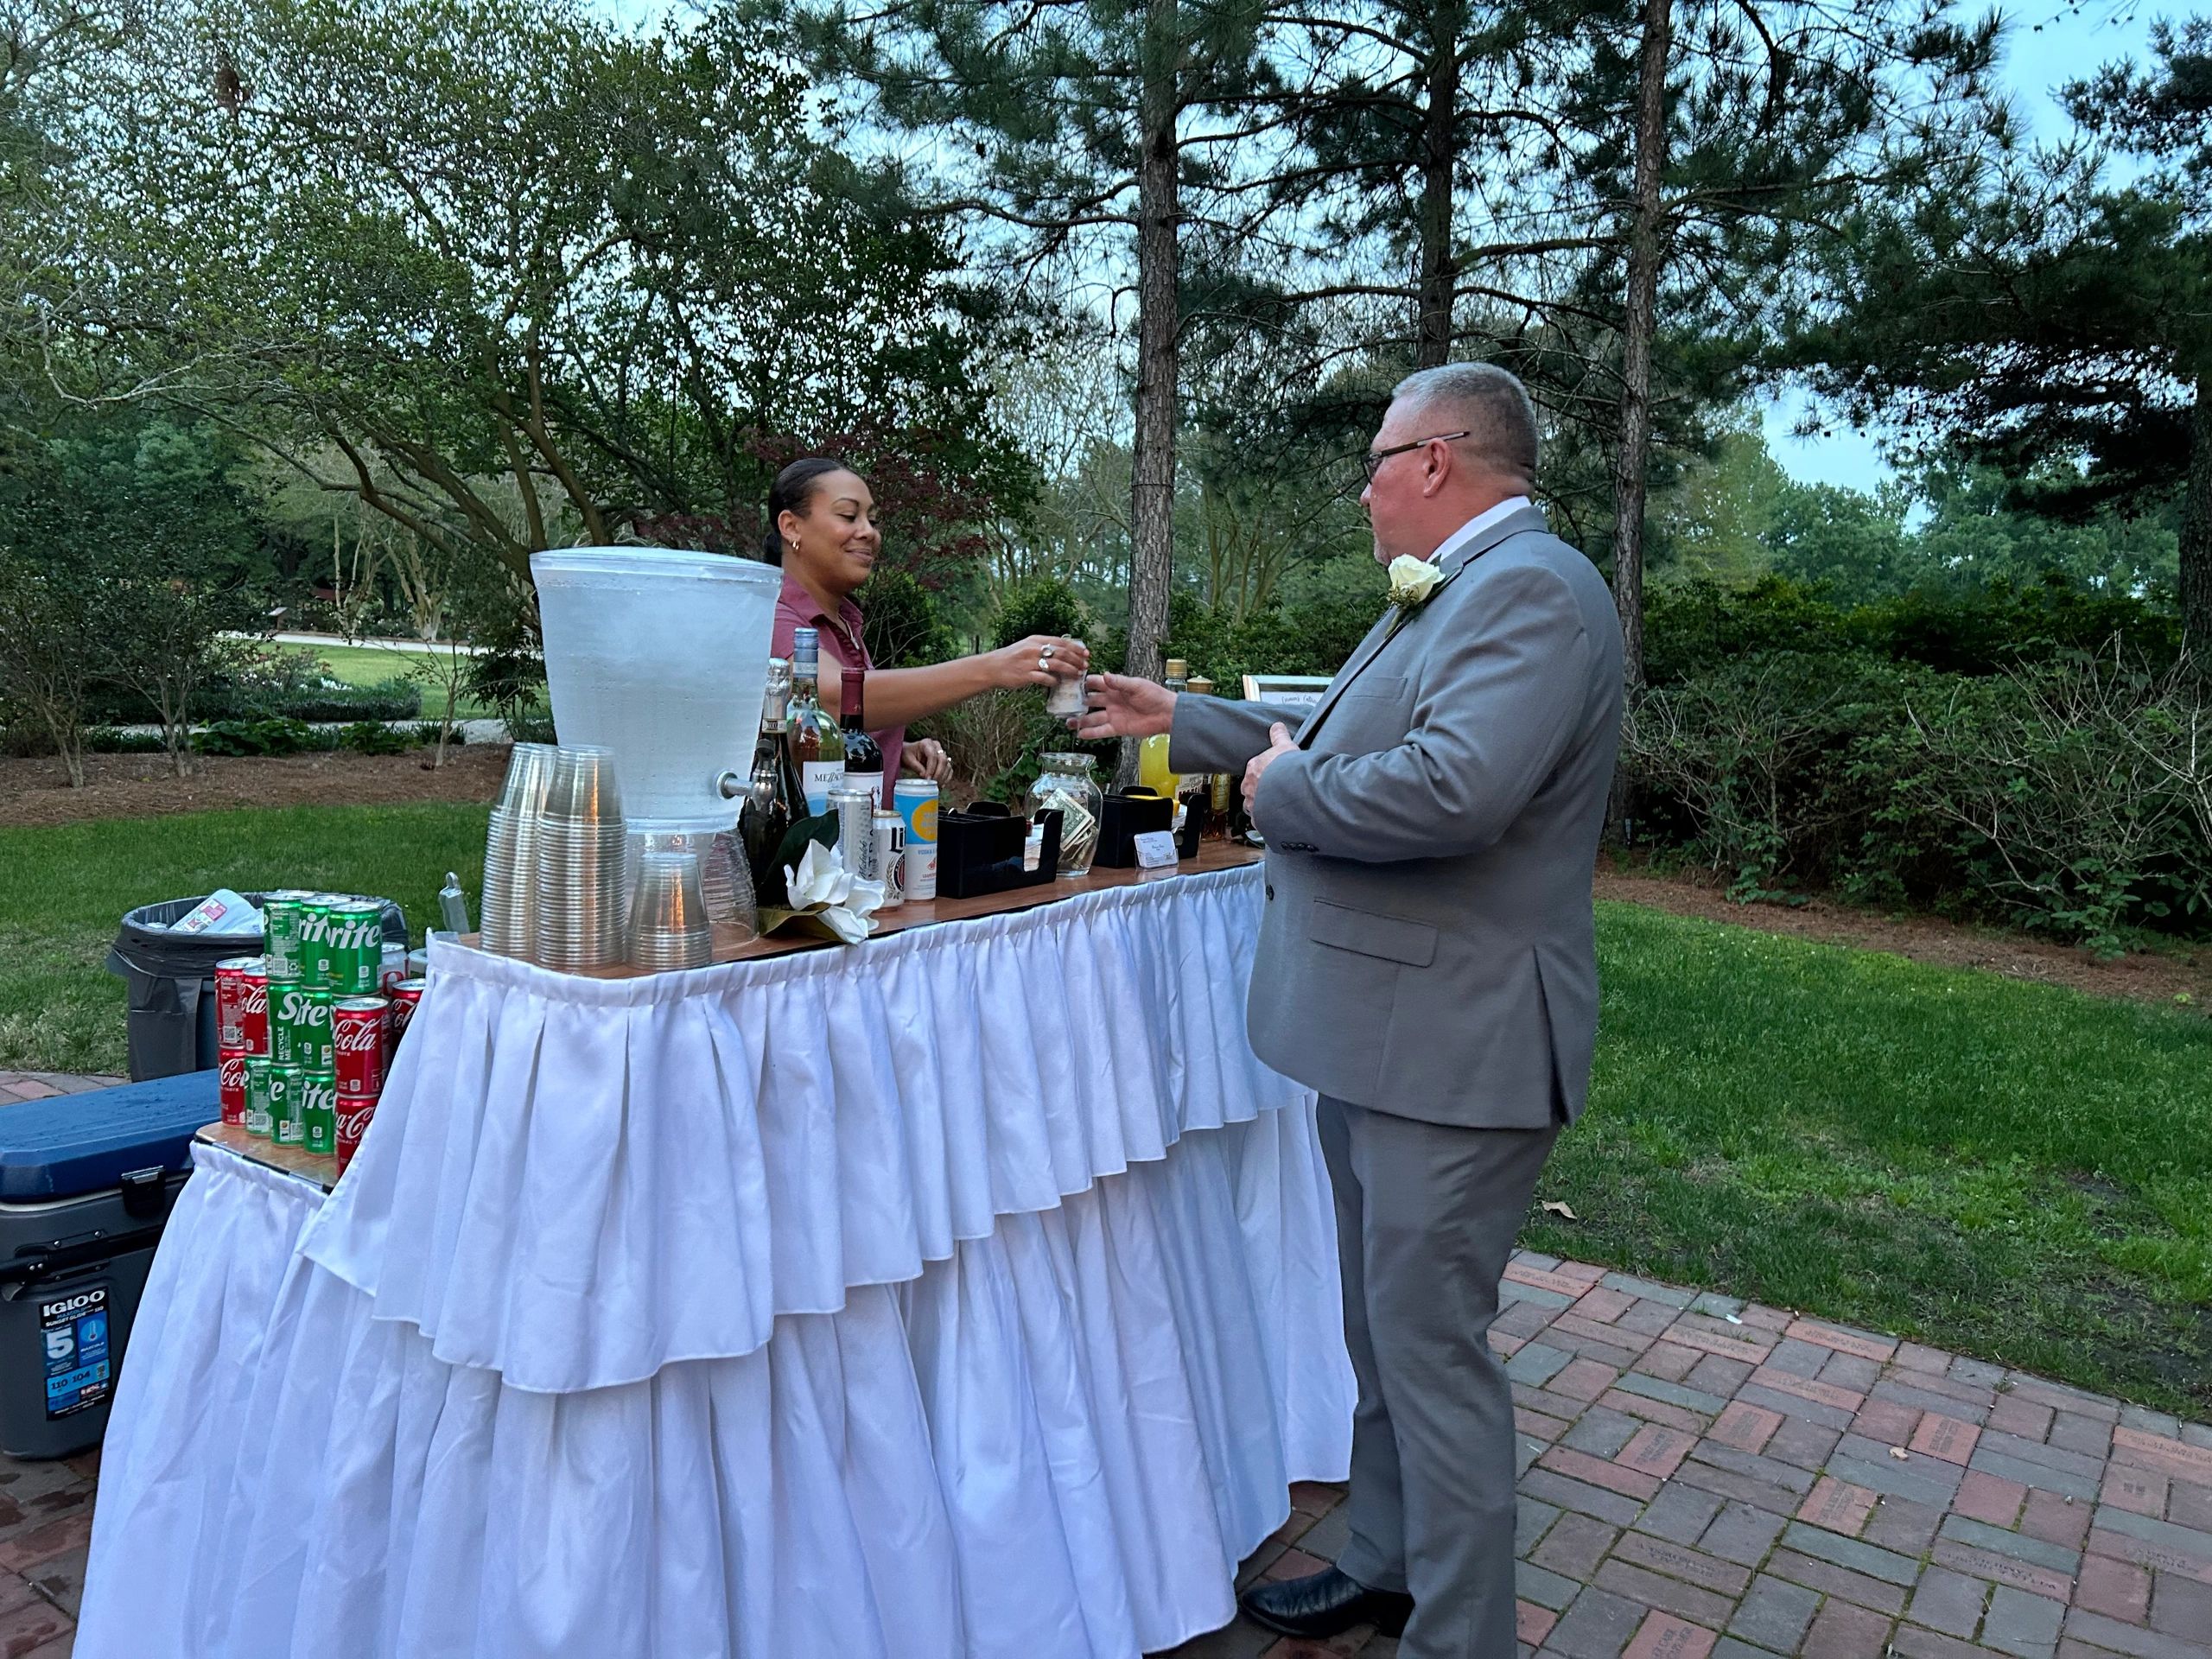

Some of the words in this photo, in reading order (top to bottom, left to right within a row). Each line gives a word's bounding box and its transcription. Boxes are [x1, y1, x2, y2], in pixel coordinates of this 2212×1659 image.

[334, 1018, 381, 1052] Cola
[284, 1048, 291, 1060] ME
[43, 1290, 105, 1318] IGLOO
[46, 1327, 74, 1359] 5
[51, 1378, 68, 1390] 110
[72, 1370, 91, 1383] 104
